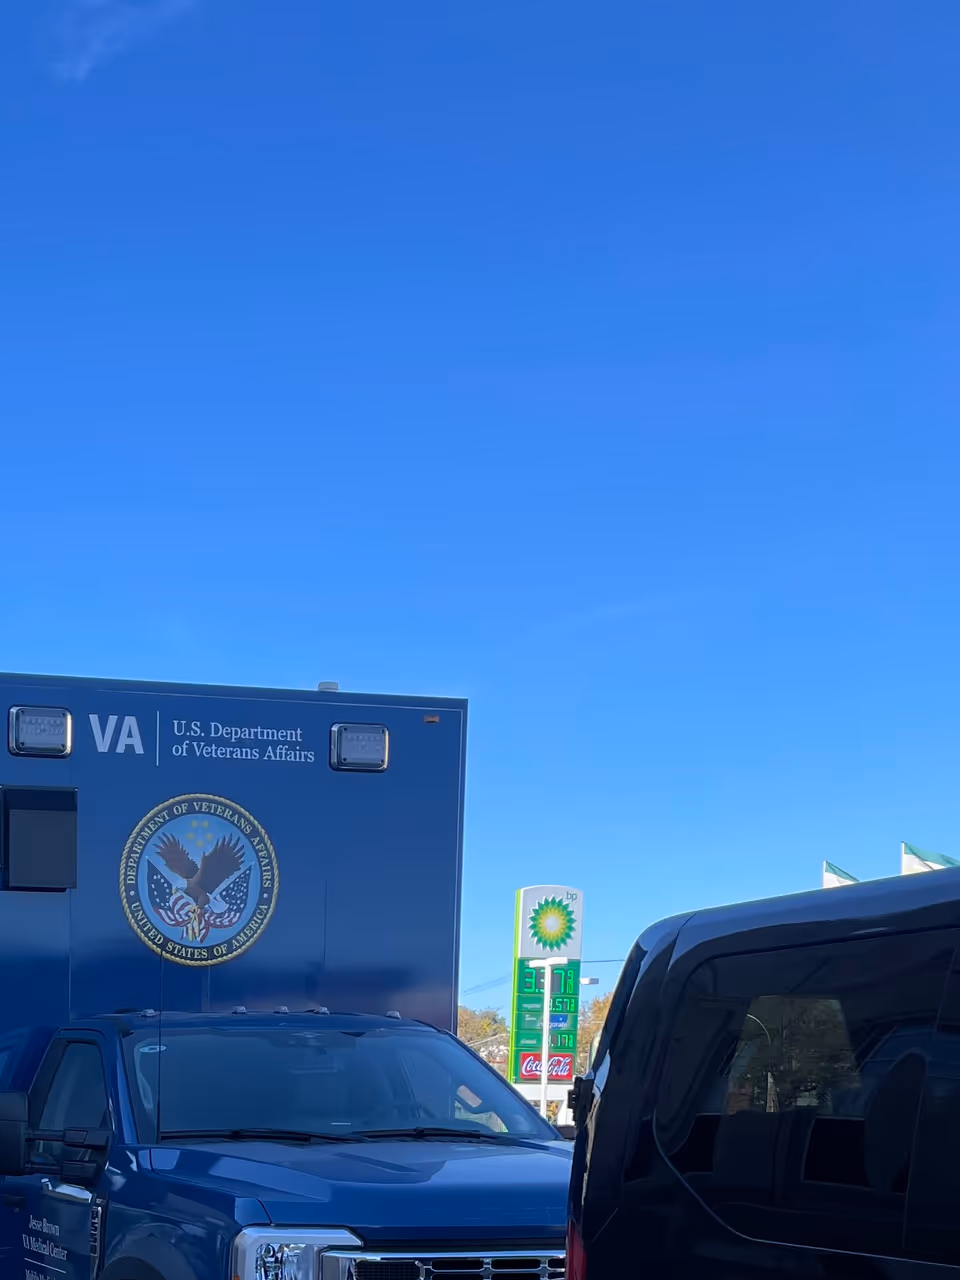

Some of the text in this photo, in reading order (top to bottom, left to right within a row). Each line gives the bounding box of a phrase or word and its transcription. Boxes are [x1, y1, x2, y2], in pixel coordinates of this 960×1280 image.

[88, 714, 144, 754] VA
[173, 720, 302, 742] U.S. Department
[172, 741, 315, 762] of Veterans Affairs
[126, 802, 272, 888] DEPARTMENT OF VETERANS AFFAIRS
[566, 891, 577, 902] bp
[131, 902, 268, 958] UNITED STATES OF AMERICA
[522, 1056, 572, 1076] CocaCola
[28, 1215, 60, 1237] Jesse Brown
[30, 1237, 49, 1255] Medical
[49, 1242, 68, 1261] Center
